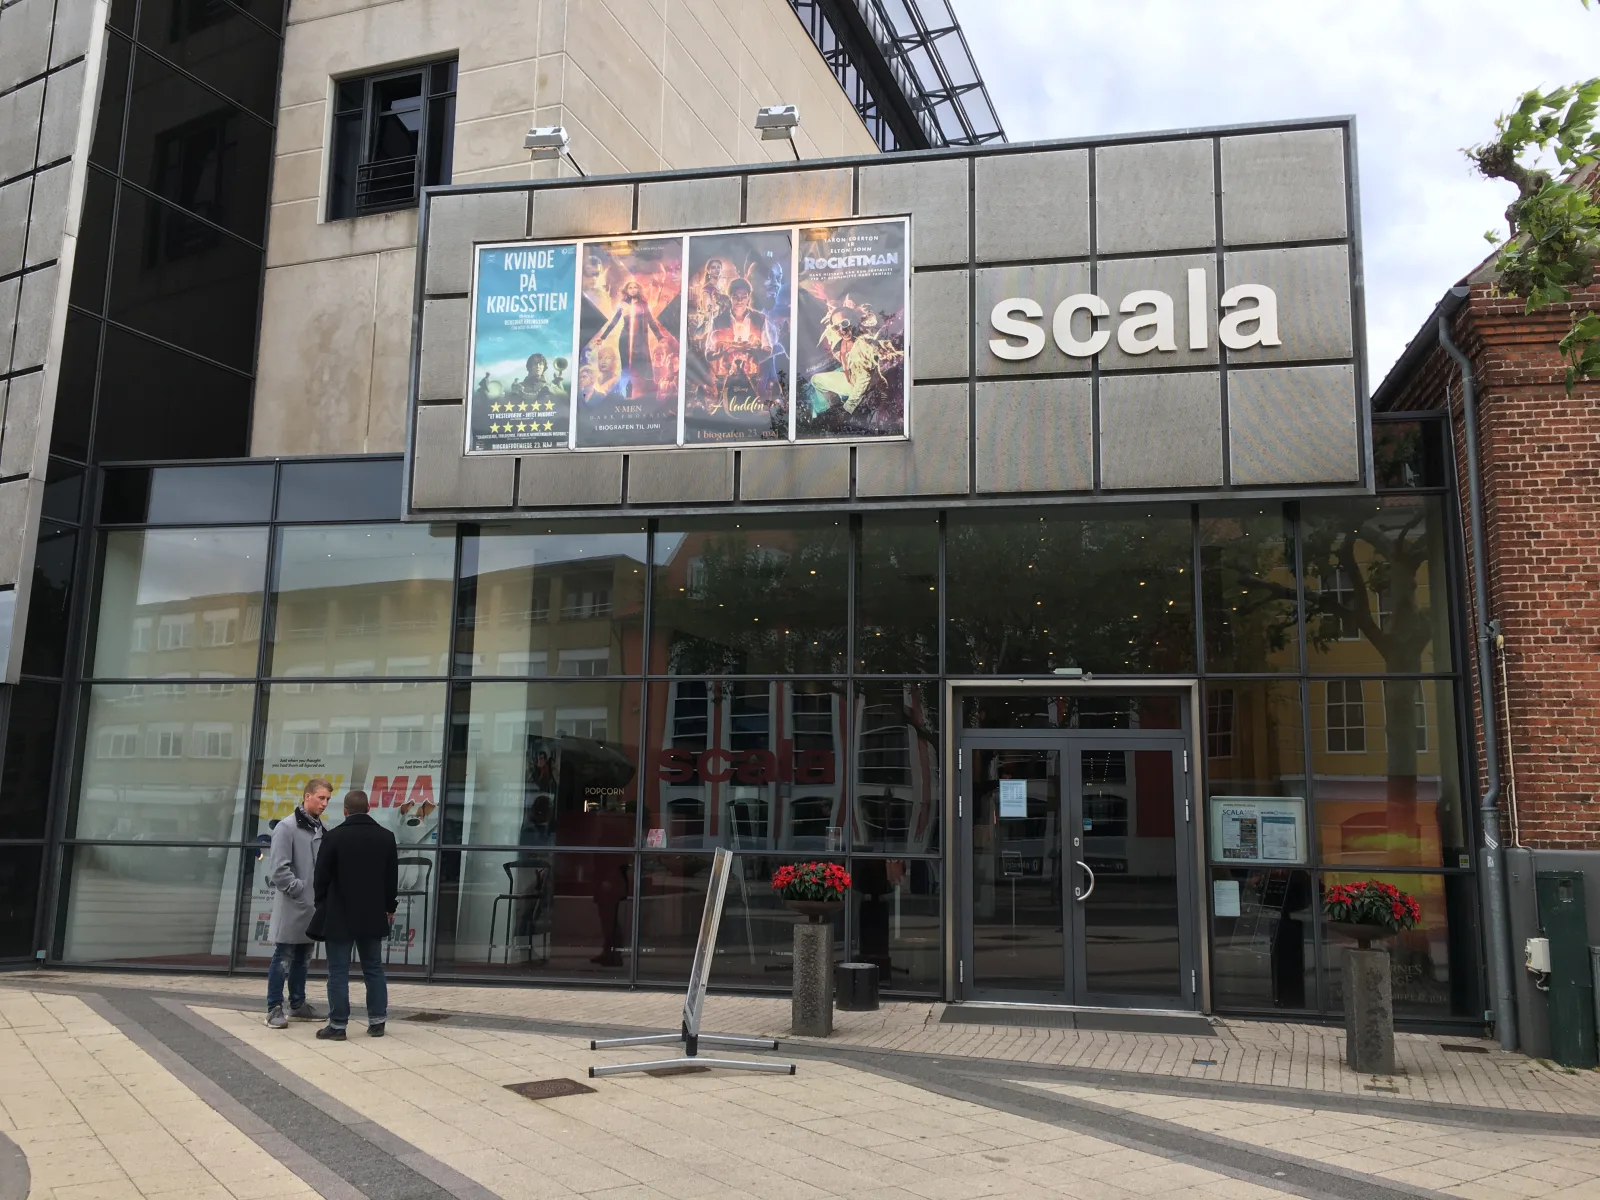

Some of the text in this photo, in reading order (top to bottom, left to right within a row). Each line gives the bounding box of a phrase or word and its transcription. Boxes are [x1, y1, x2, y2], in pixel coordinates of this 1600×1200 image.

[504, 250, 555, 270] KVINDE
[804, 252, 898, 270] ROCKETMAN
[520, 270, 537, 292] PÅ
[486, 292, 568, 313] KRIGSSTIEN
[988, 268, 1282, 360] scala
[710, 388, 764, 419] Aladdin
[703, 430, 745, 440] biografen
[762, 429, 779, 438] maj
[658, 738, 835, 783] scala
[585, 787, 625, 796] POPCORN
[408, 928, 416, 947] 2
[1390, 964, 1422, 974] RNES
